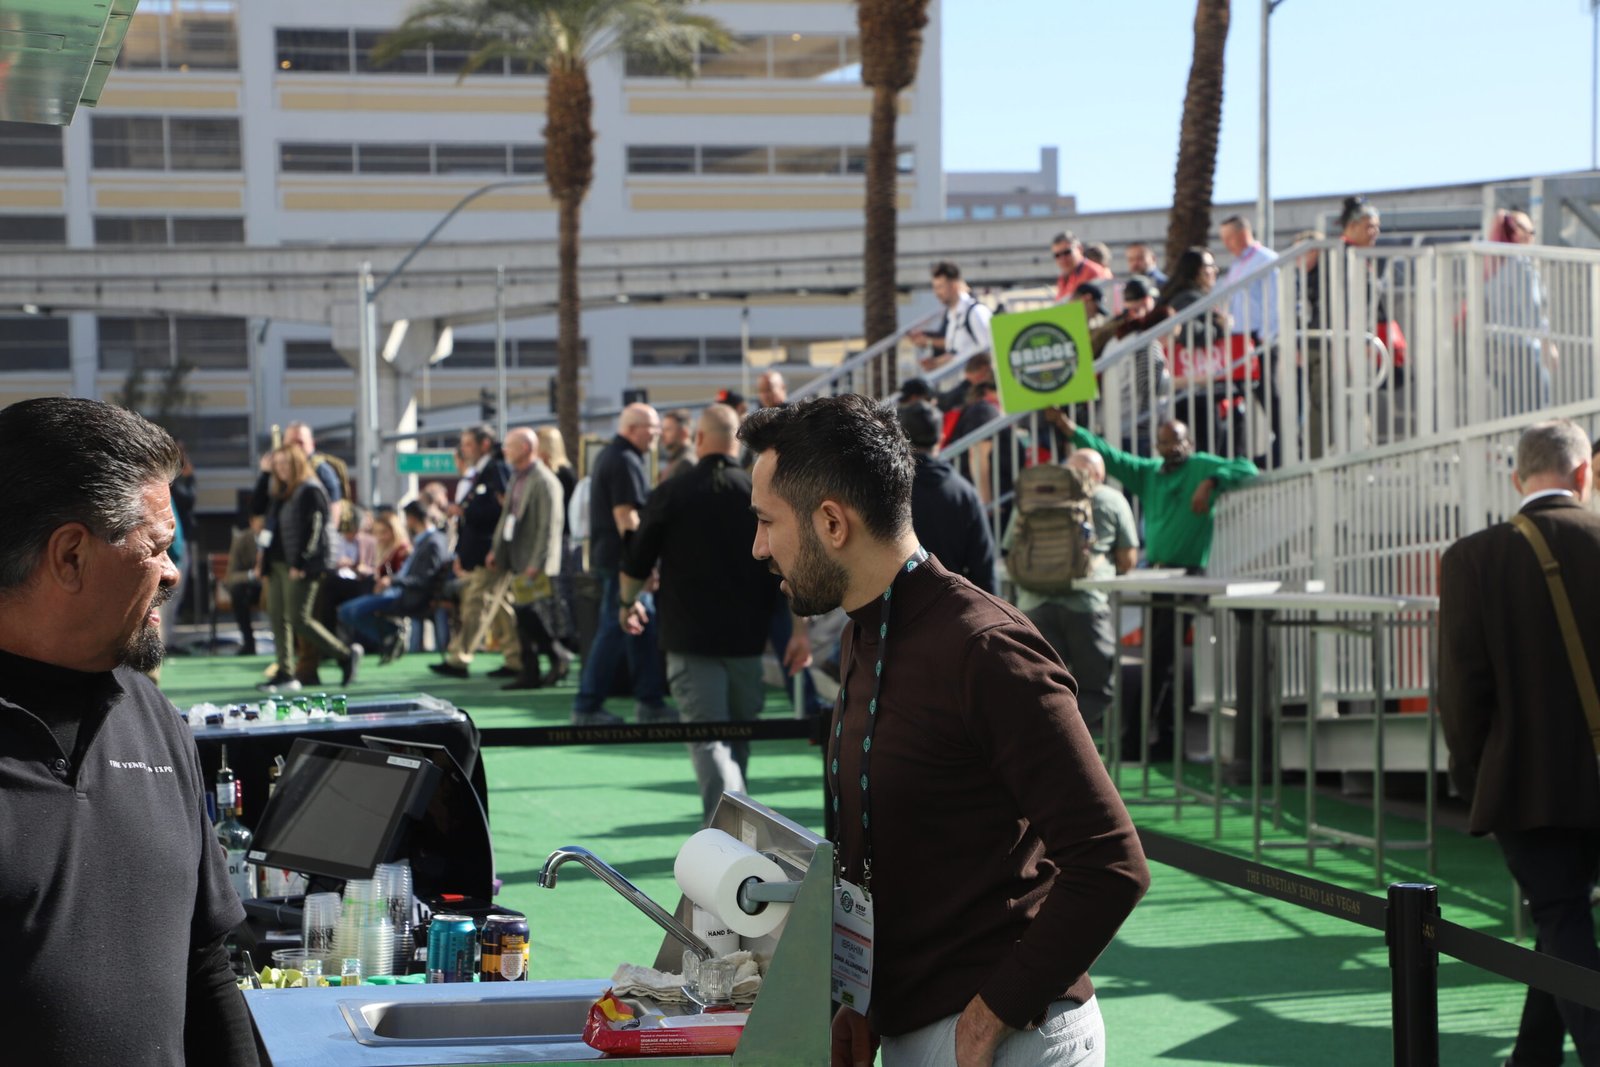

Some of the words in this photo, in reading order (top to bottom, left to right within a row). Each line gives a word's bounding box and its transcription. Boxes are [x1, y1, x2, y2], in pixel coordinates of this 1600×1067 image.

[1011, 341, 1076, 367] BRIDGE
[548, 731, 572, 741] THE
[576, 729, 641, 740] VENETIAN
[648, 728, 682, 739] EXPO
[686, 727, 709, 738] LAS
[711, 726, 753, 737] VEGAS
[109, 759, 121, 768] THE
[154, 765, 173, 773] EXPO
[1247, 870, 1260, 884] THE
[1261, 873, 1298, 894] VENETIAN
[1299, 884, 1320, 902] EXPO
[1321, 889, 1335, 907] LAS
[1336, 895, 1361, 915] VEGAS
